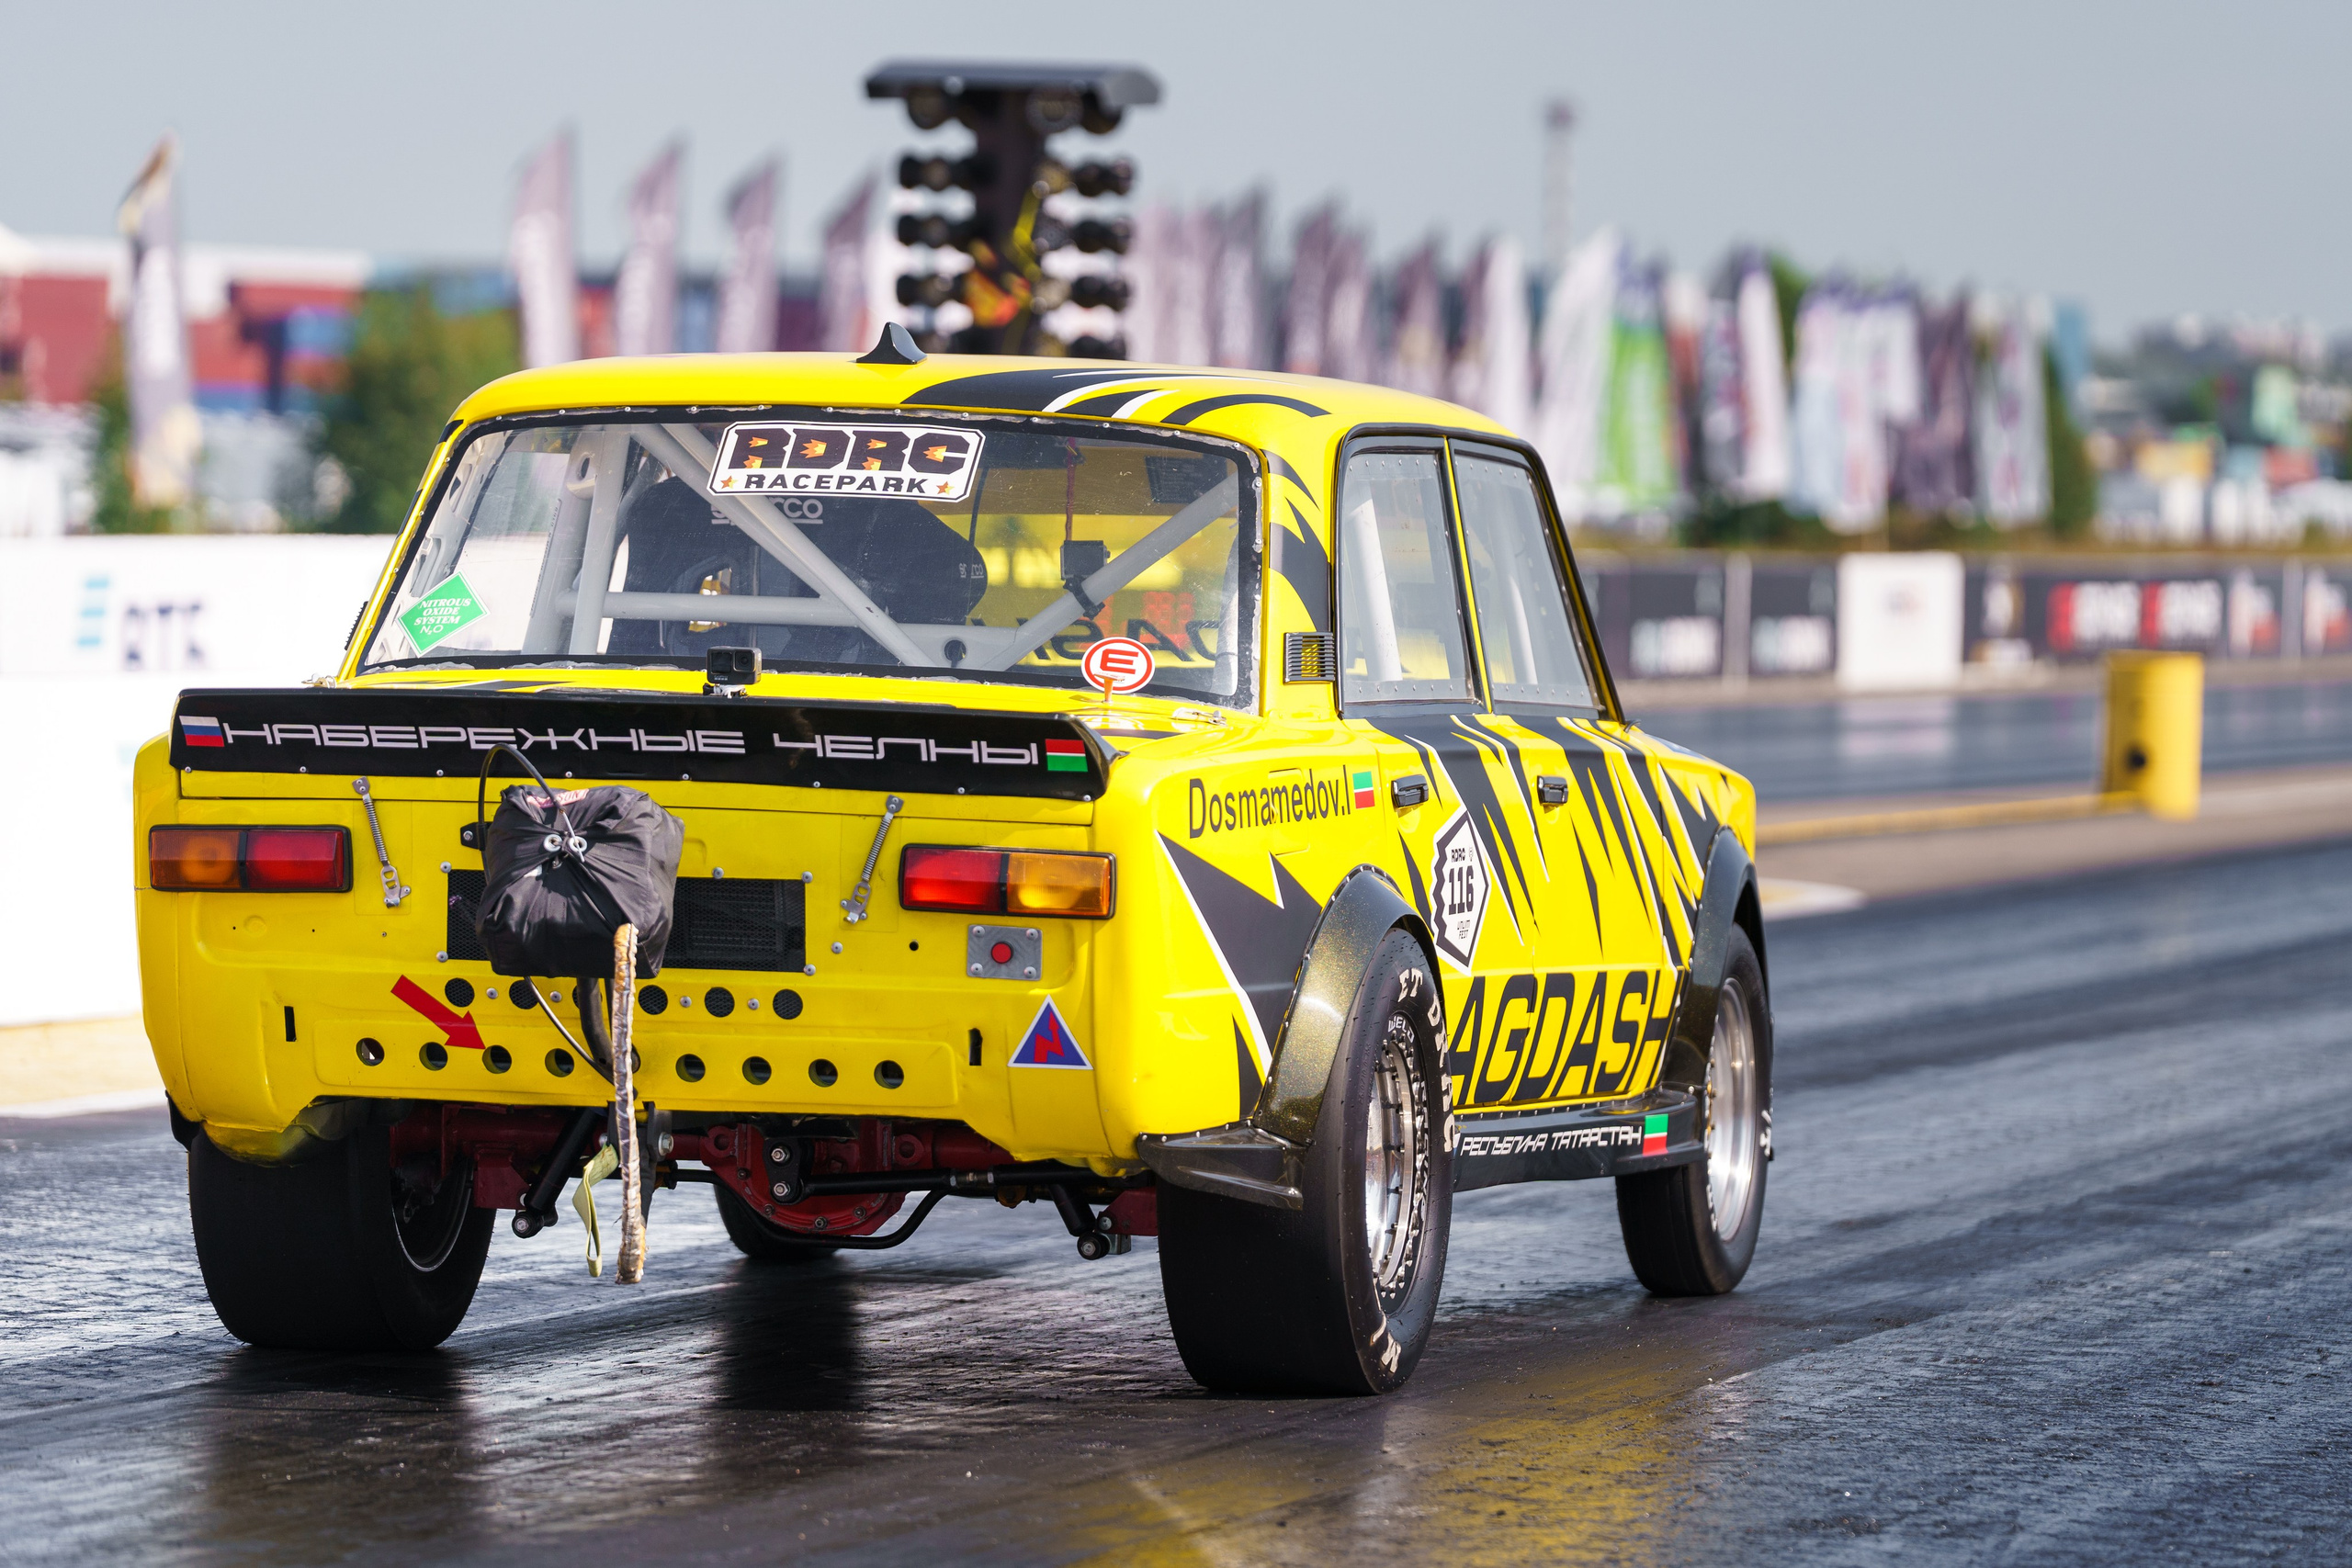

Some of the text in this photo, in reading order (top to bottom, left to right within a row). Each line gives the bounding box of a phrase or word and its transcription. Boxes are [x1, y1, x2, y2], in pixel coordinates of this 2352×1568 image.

[728, 428, 970, 474] RDRC
[744, 474, 928, 493] RACEPARK
[419, 598, 471, 608] NITROUS
[423, 607, 459, 615] OXIDE
[413, 615, 461, 625] SYSTEM
[223, 723, 1039, 765] НАБЕРЕЖНЫЕ ЧЕЛНЫ
[1448, 865, 1474, 915] 116
[1388, 1015, 1415, 1043] WELD
[1448, 970, 1669, 1106] AGDASH
[1397, 967, 1455, 1152] ET DRAG
[1460, 1126, 1643, 1156] РЕСПУБЛИКА ТАТАРСТАН
